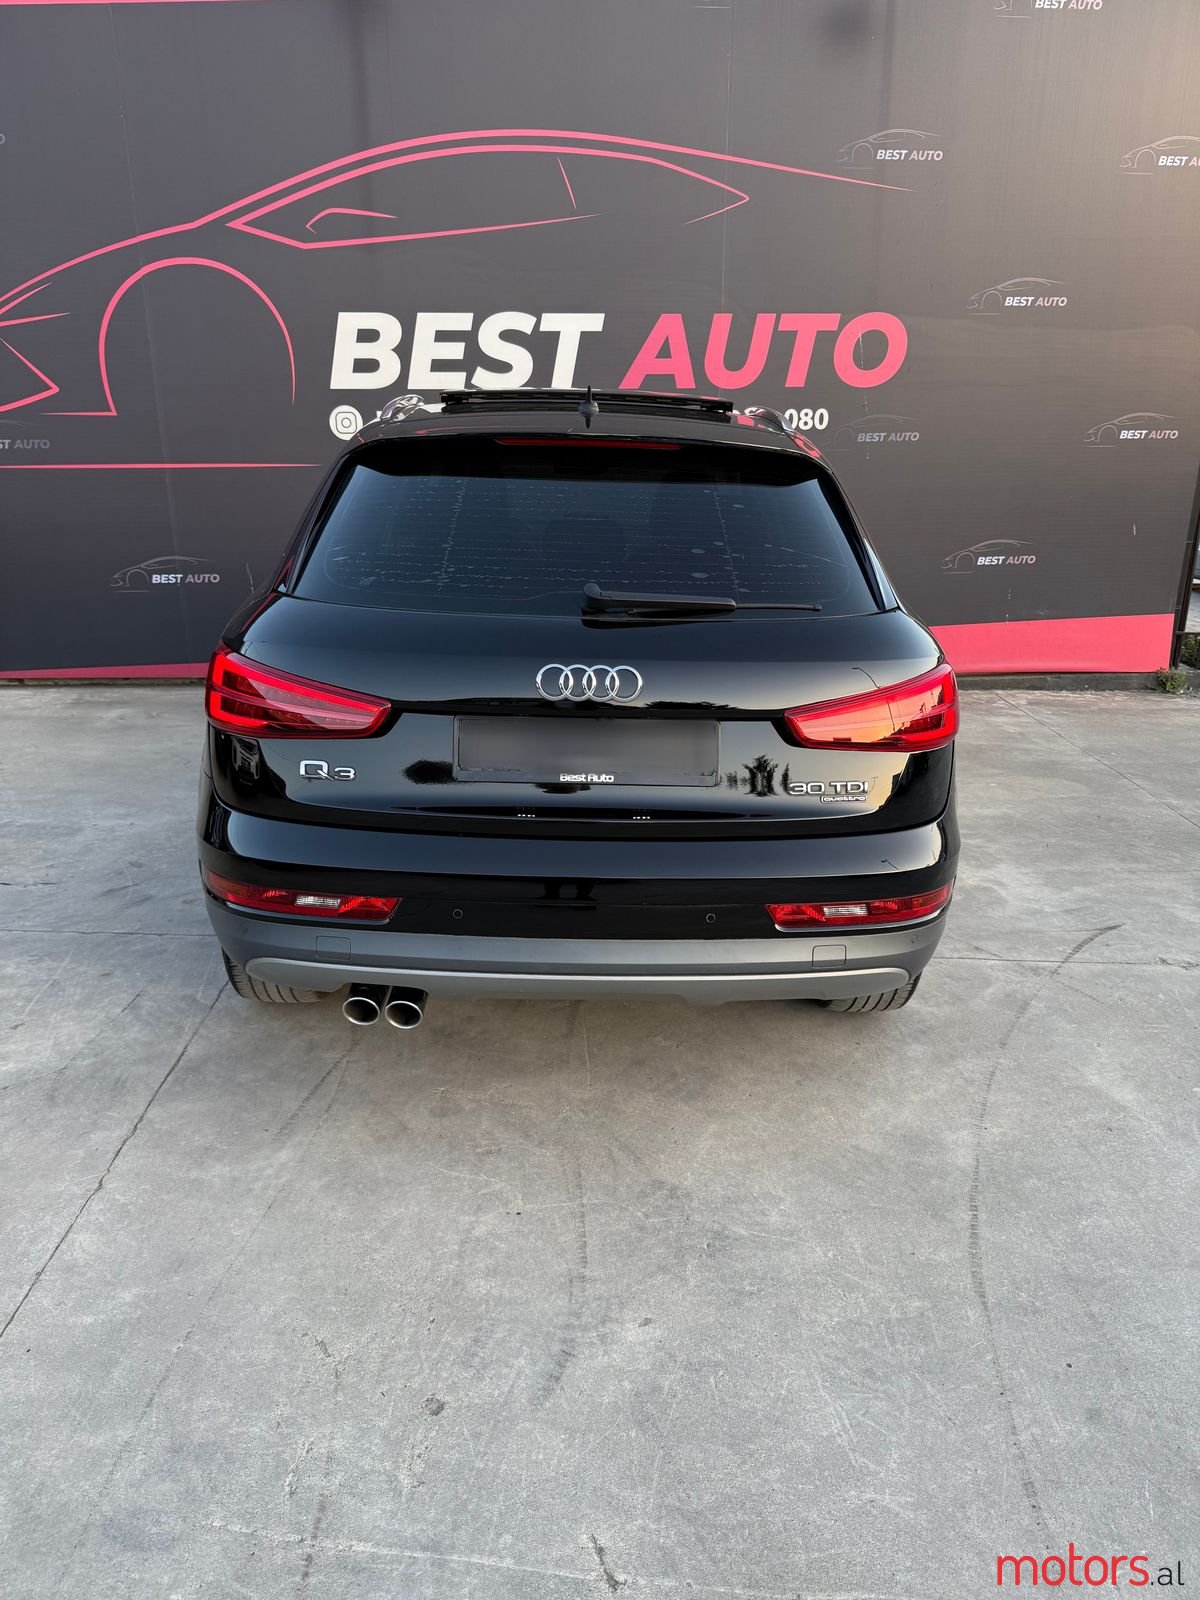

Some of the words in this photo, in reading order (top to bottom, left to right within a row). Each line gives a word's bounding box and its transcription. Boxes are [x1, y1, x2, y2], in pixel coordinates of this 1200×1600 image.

[1035, 0, 1066, 8] BEST
[1068, 0, 1103, 10] AUTO
[876, 149, 908, 160] BEST
[909, 150, 944, 161] AUTO
[1158, 155, 1189, 166] BEST
[1004, 296, 1034, 307] BEST
[1035, 297, 1068, 307] AUTO
[329, 311, 605, 390] BEST
[618, 312, 908, 389] AUTO
[857, 432, 886, 442] BEST
[888, 432, 920, 442] AUTO
[1119, 430, 1148, 440] BEST
[1148, 430, 1179, 440] AUTO
[14, 439, 50, 449] AUTO
[976, 556, 1006, 566] BEST
[1005, 555, 1036, 565] AUTO
[151, 574, 183, 584] BEST
[185, 574, 220, 583] AUTO
[300, 760, 356, 780] Q3
[560, 773, 586, 782] Best
[587, 773, 615, 783] Auto
[789, 782, 825, 795] 30
[830, 781, 869, 793] TDI
[822, 795, 867, 803] quattro
